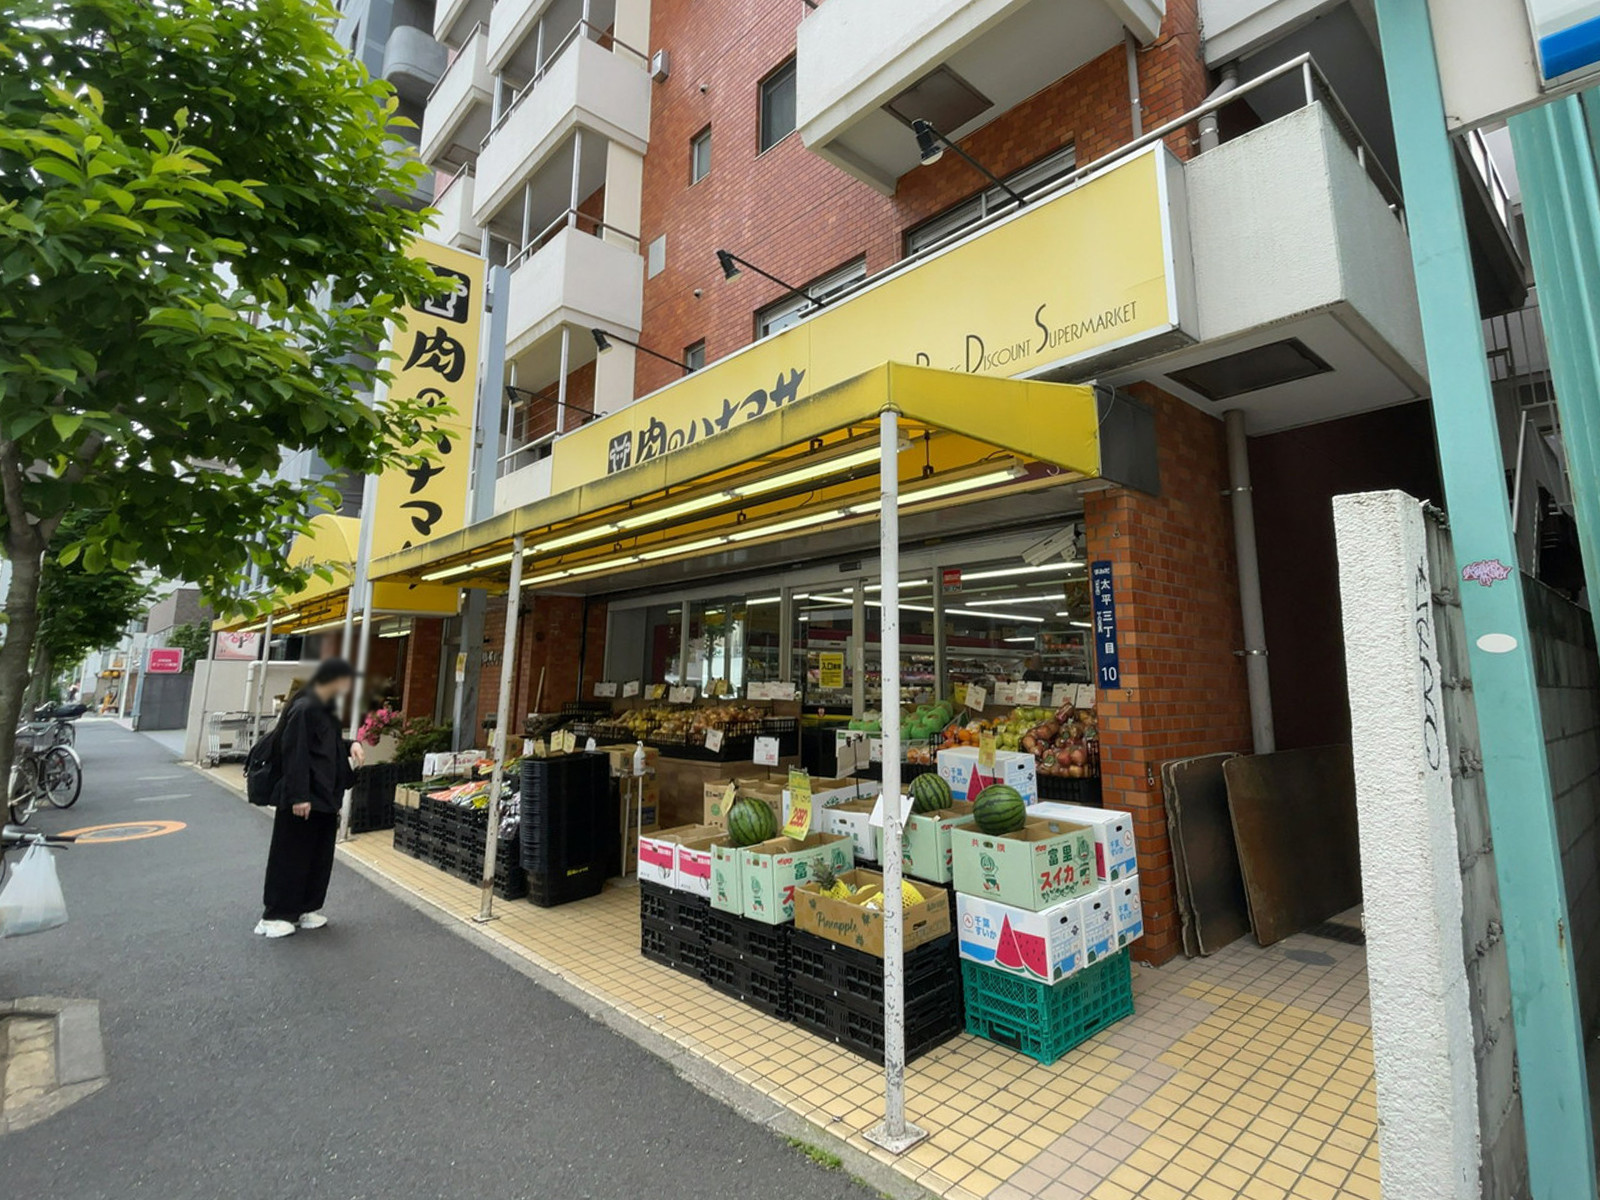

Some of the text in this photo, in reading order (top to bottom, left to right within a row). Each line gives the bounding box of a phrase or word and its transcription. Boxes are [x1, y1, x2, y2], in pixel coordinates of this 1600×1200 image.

[1101, 579, 1114, 654] 太平三丁目
[1102, 667, 1117, 681] 10
[1047, 844, 1073, 867] 富里
[1040, 864, 1075, 891] スイカ
[816, 911, 858, 936] Pineapple
[974, 915, 991, 929] 千葉
[974, 926, 998, 940] すいか
